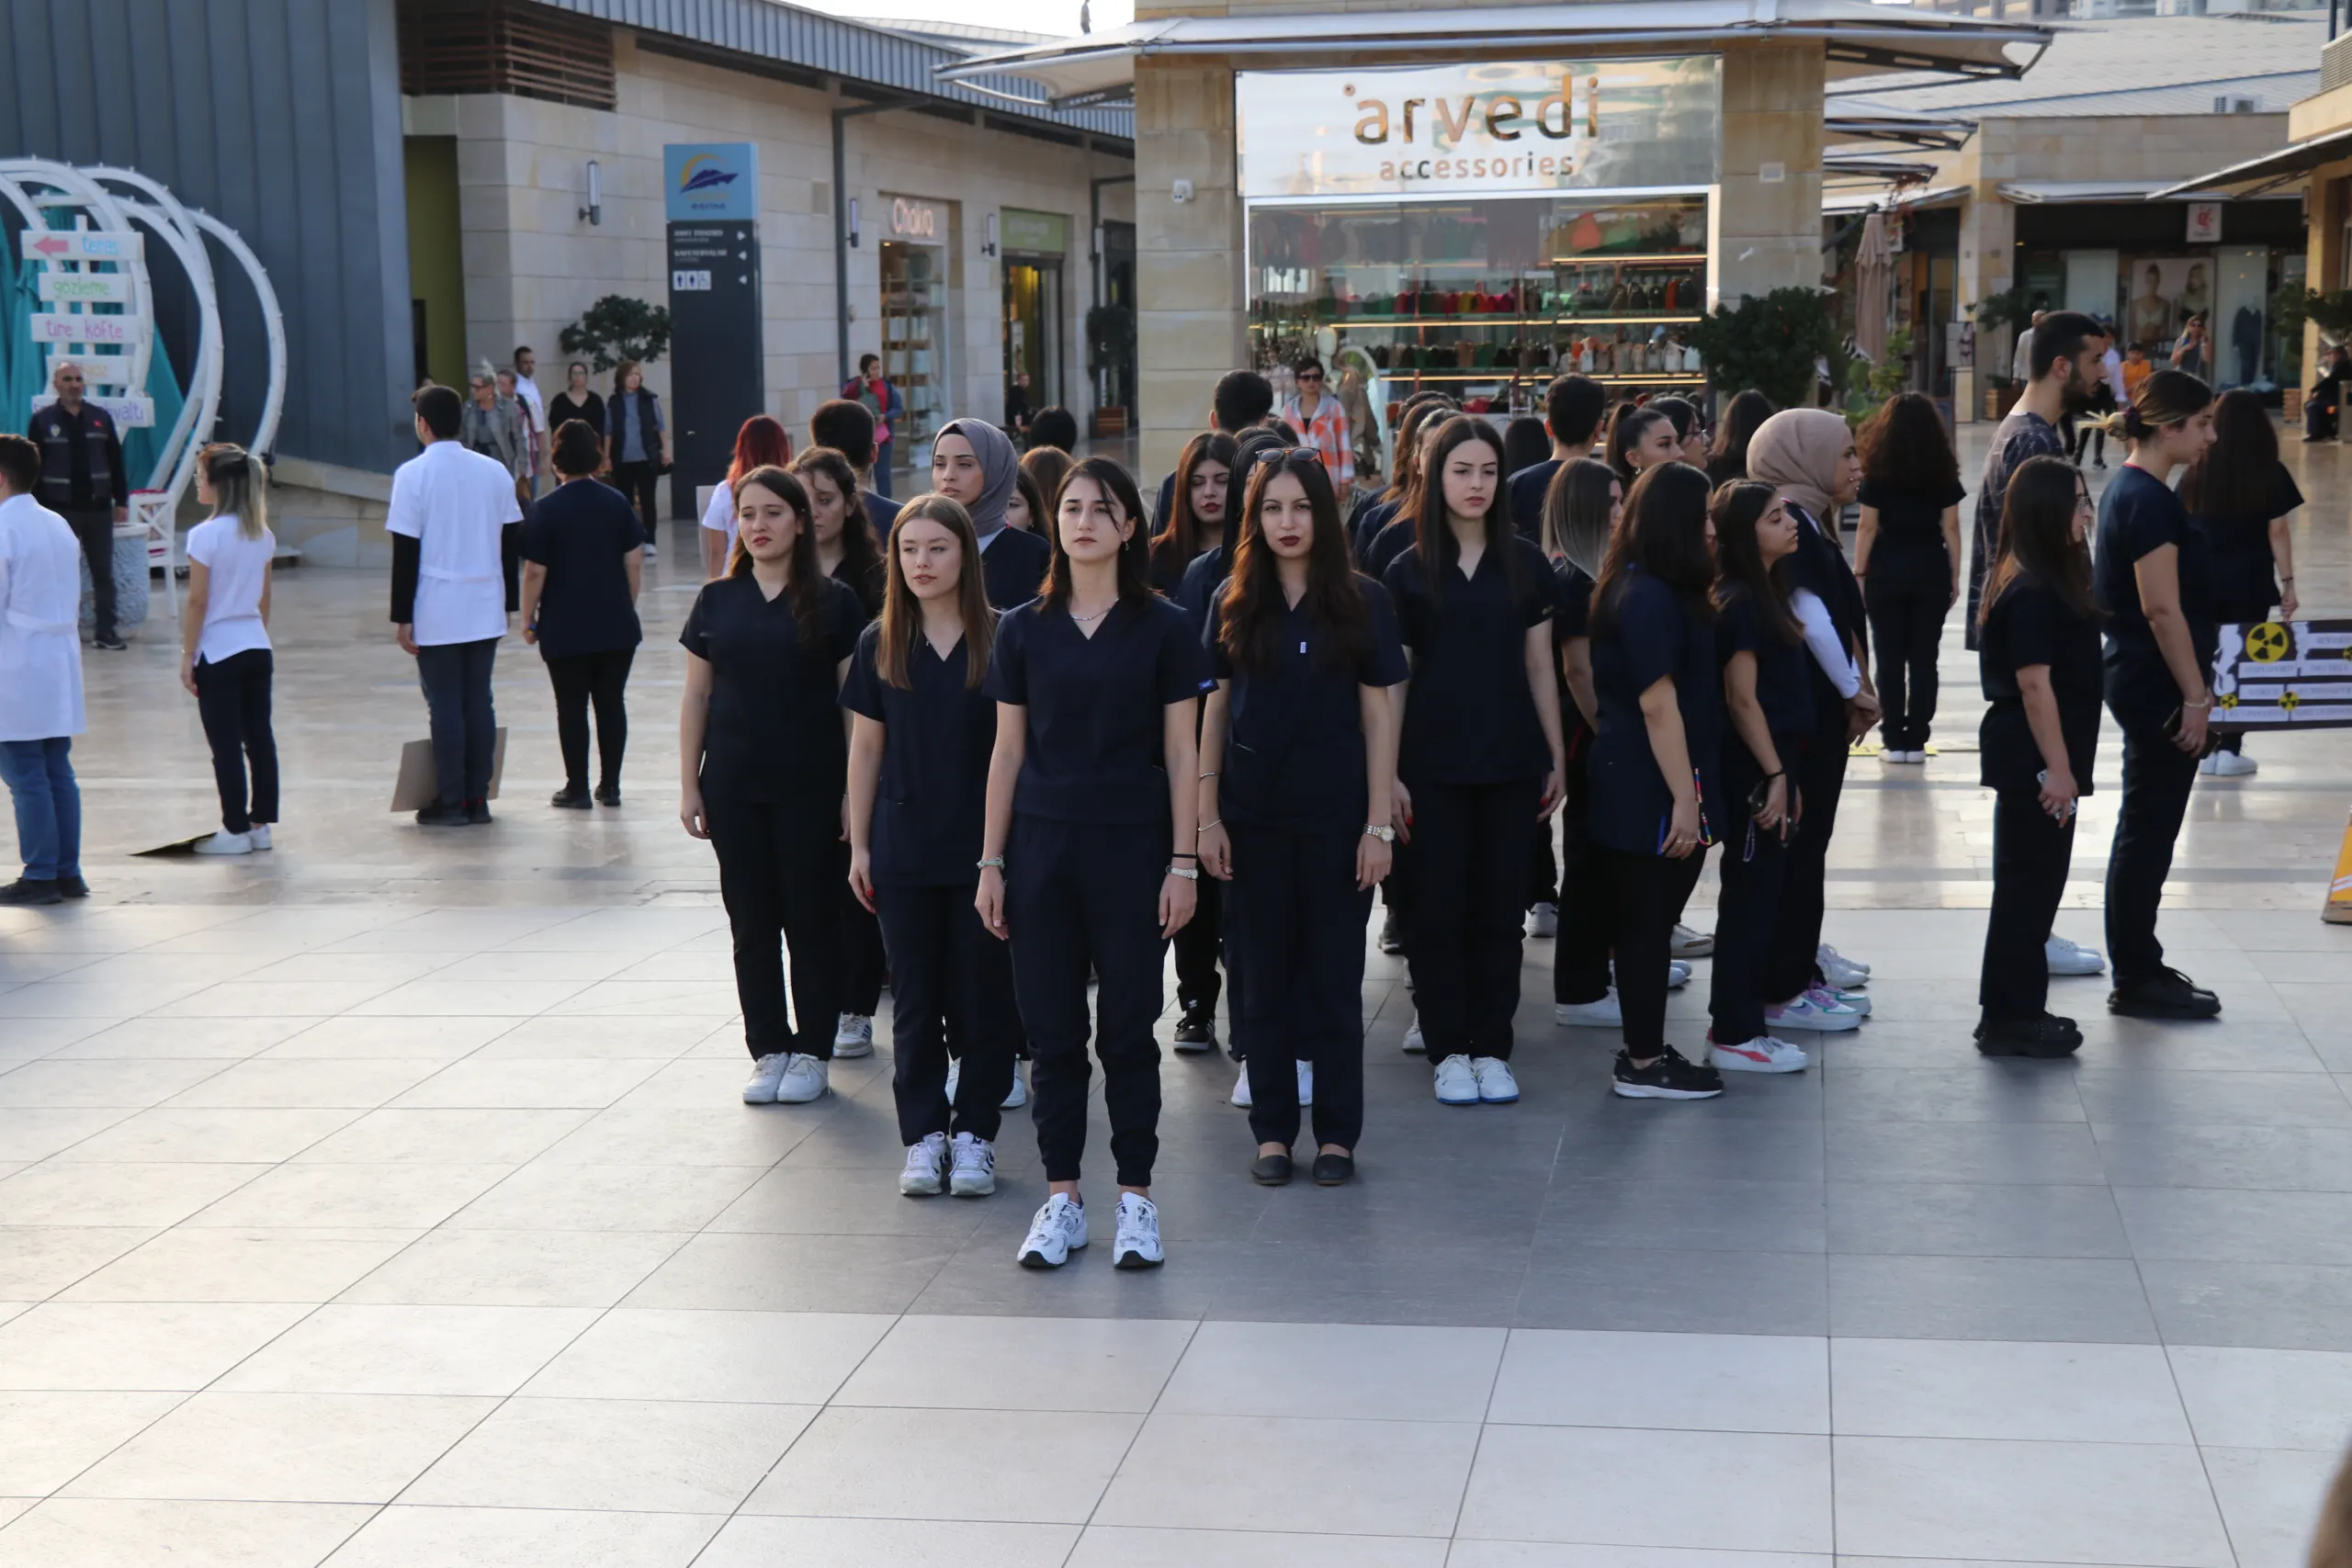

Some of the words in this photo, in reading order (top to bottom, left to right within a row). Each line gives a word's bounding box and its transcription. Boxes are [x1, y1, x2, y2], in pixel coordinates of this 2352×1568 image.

[1354, 74, 1599, 144] arvedi
[1380, 151, 1573, 181] accessories
[82, 235, 119, 255] teras
[52, 276, 109, 299] gözleme
[85, 320, 123, 339] köfte
